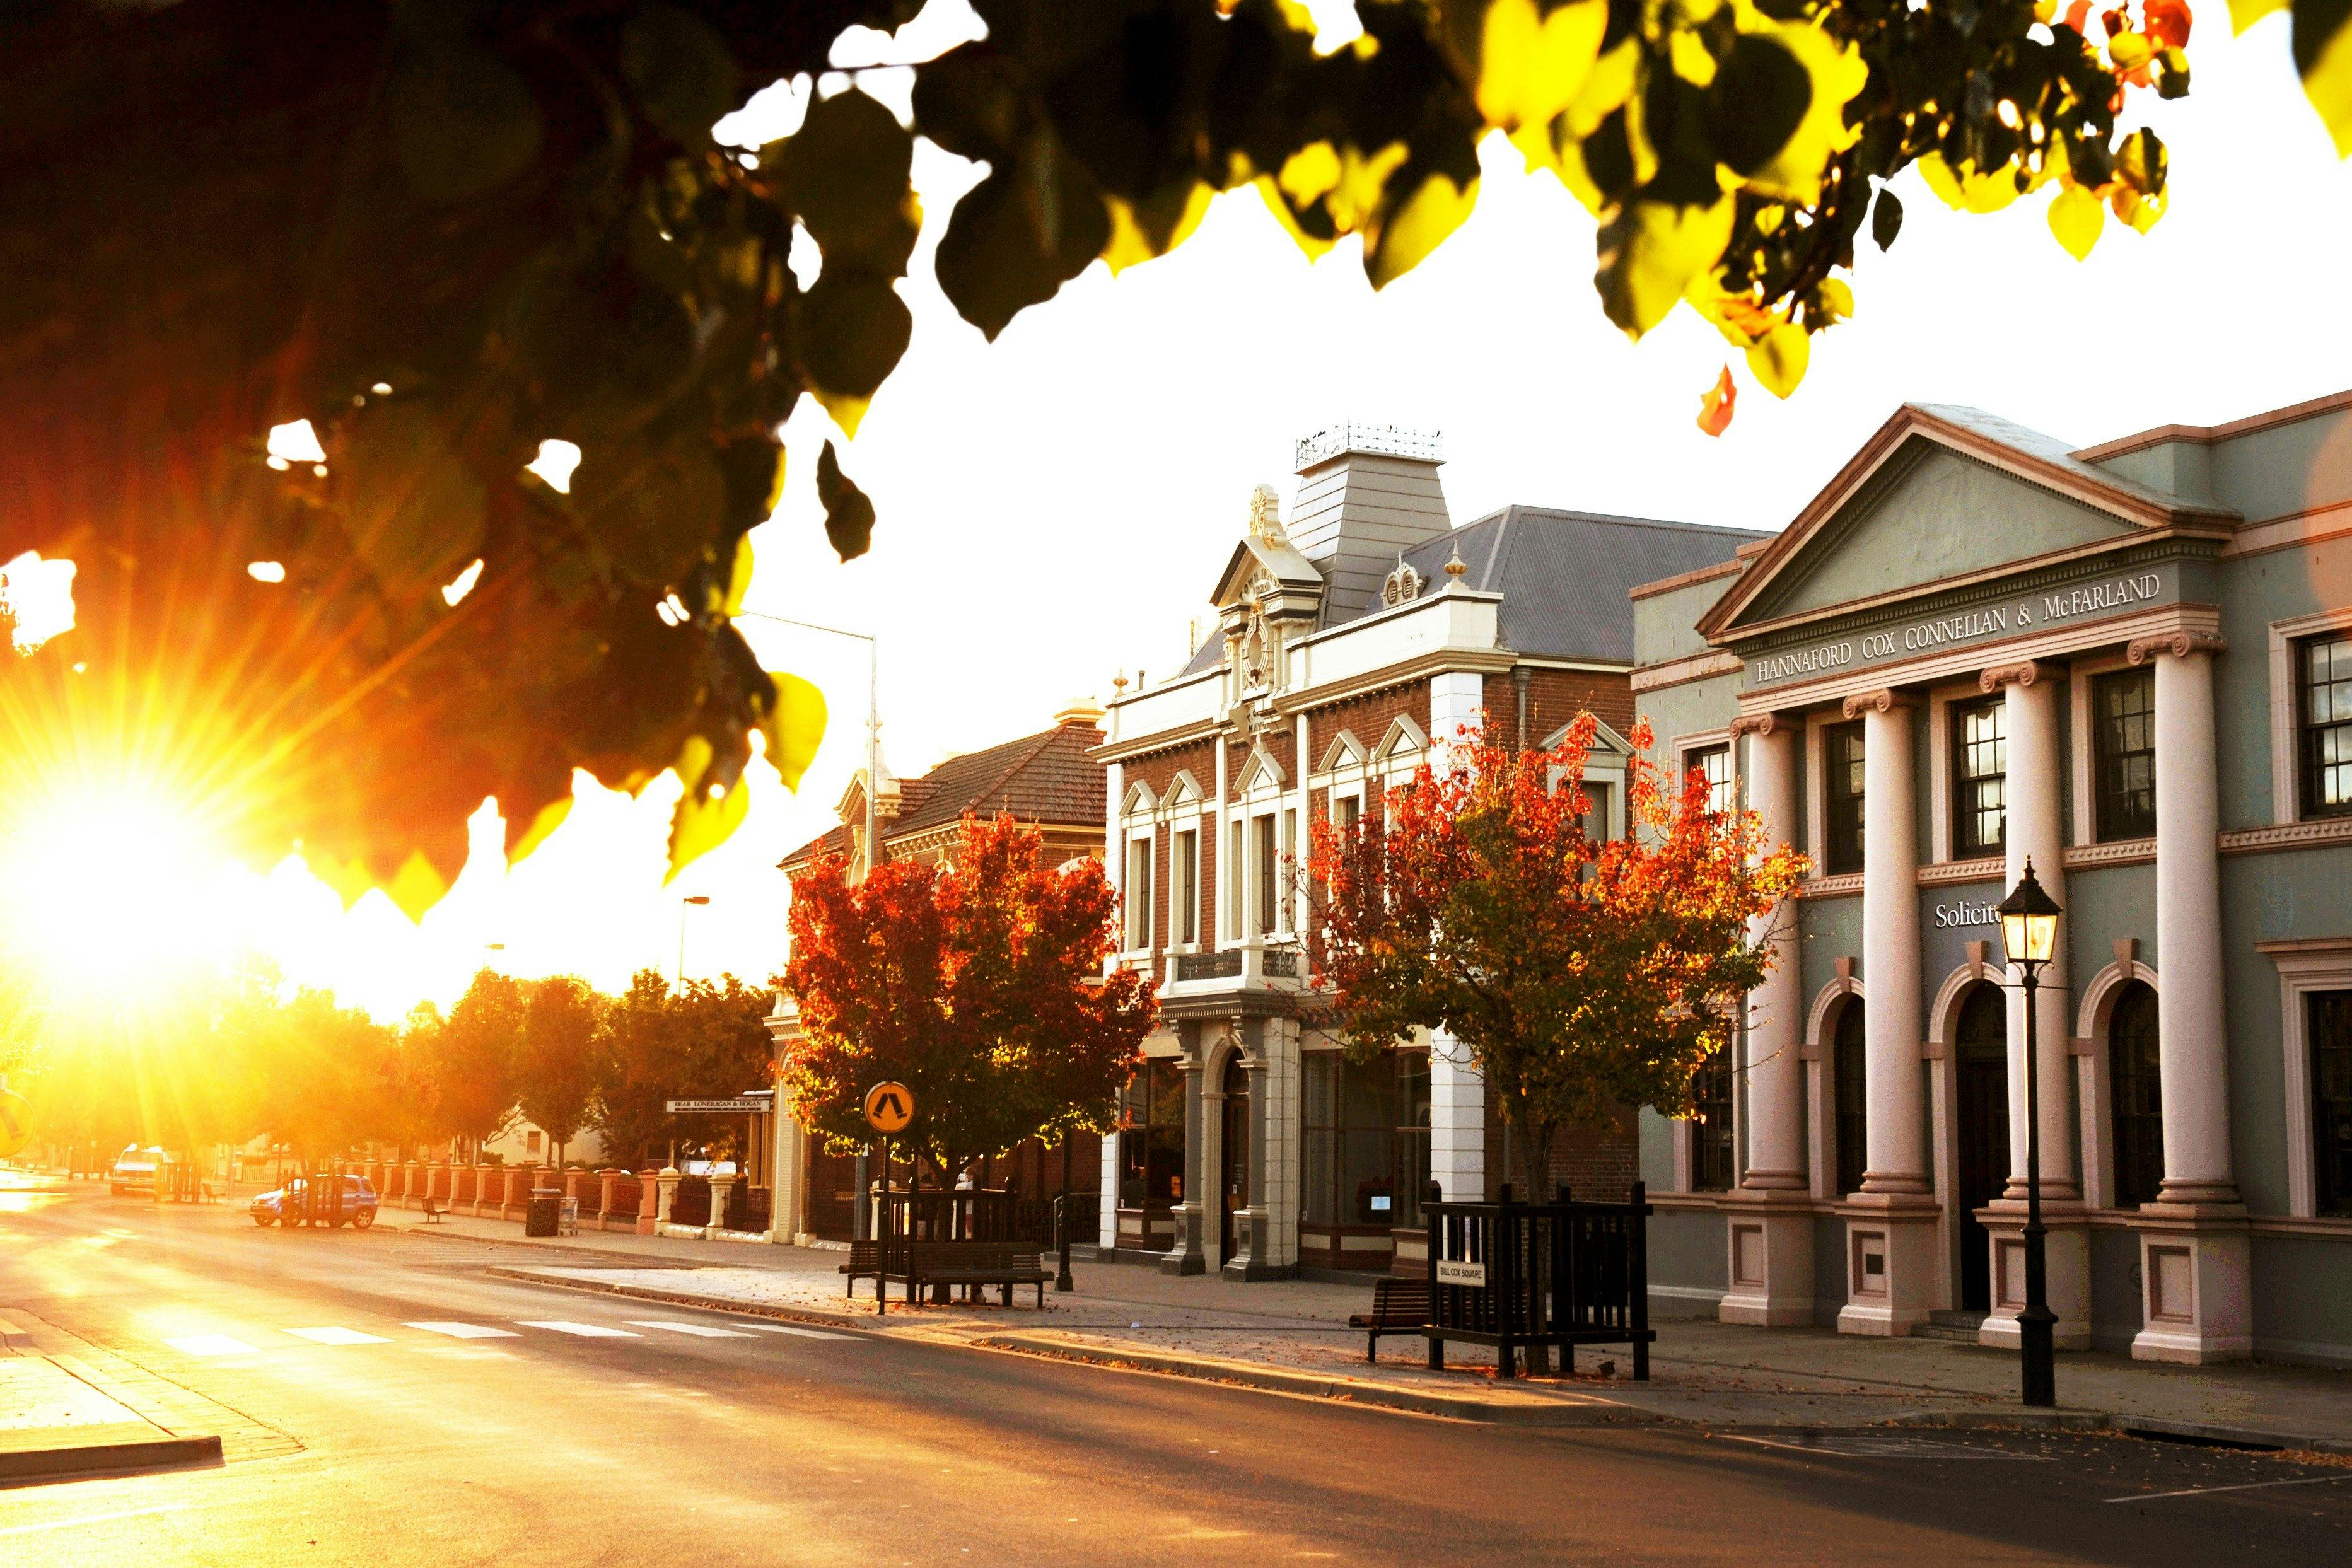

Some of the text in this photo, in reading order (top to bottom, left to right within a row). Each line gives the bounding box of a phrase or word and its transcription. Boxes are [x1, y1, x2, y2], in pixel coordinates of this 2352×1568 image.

[1757, 574, 2160, 682] HANNAFORD COX CONNELLAN & McFARLAND
[1936, 900, 2002, 927] Solicito
[1440, 1267, 1482, 1279] BILL COX SQUARE
